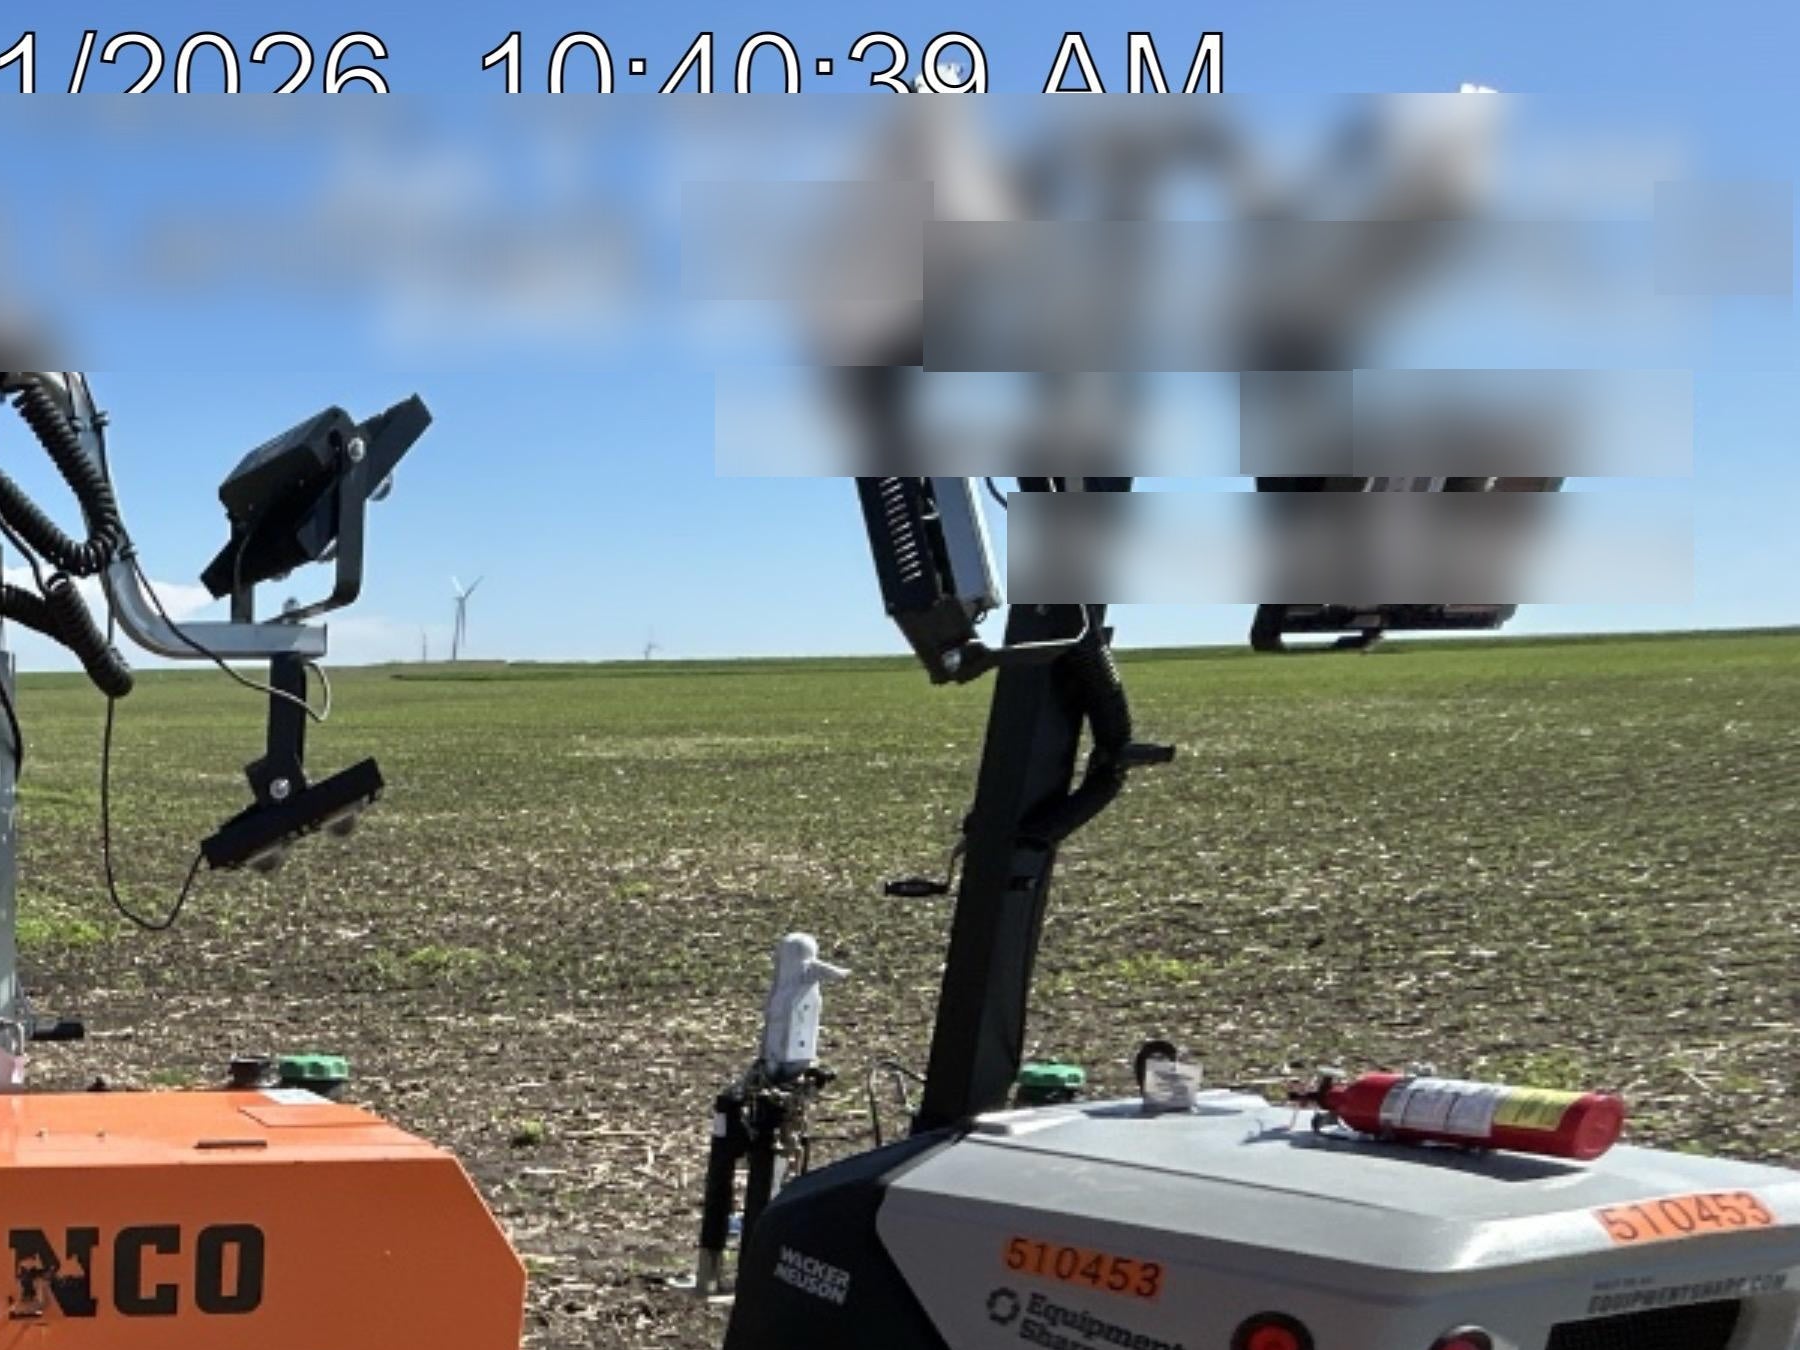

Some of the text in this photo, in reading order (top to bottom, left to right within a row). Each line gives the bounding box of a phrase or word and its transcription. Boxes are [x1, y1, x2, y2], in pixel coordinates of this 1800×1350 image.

[1603, 1192, 1771, 1240] 510453
[773, 1262, 848, 1305] NEUSON
[1006, 1236, 1161, 1298] 510453
